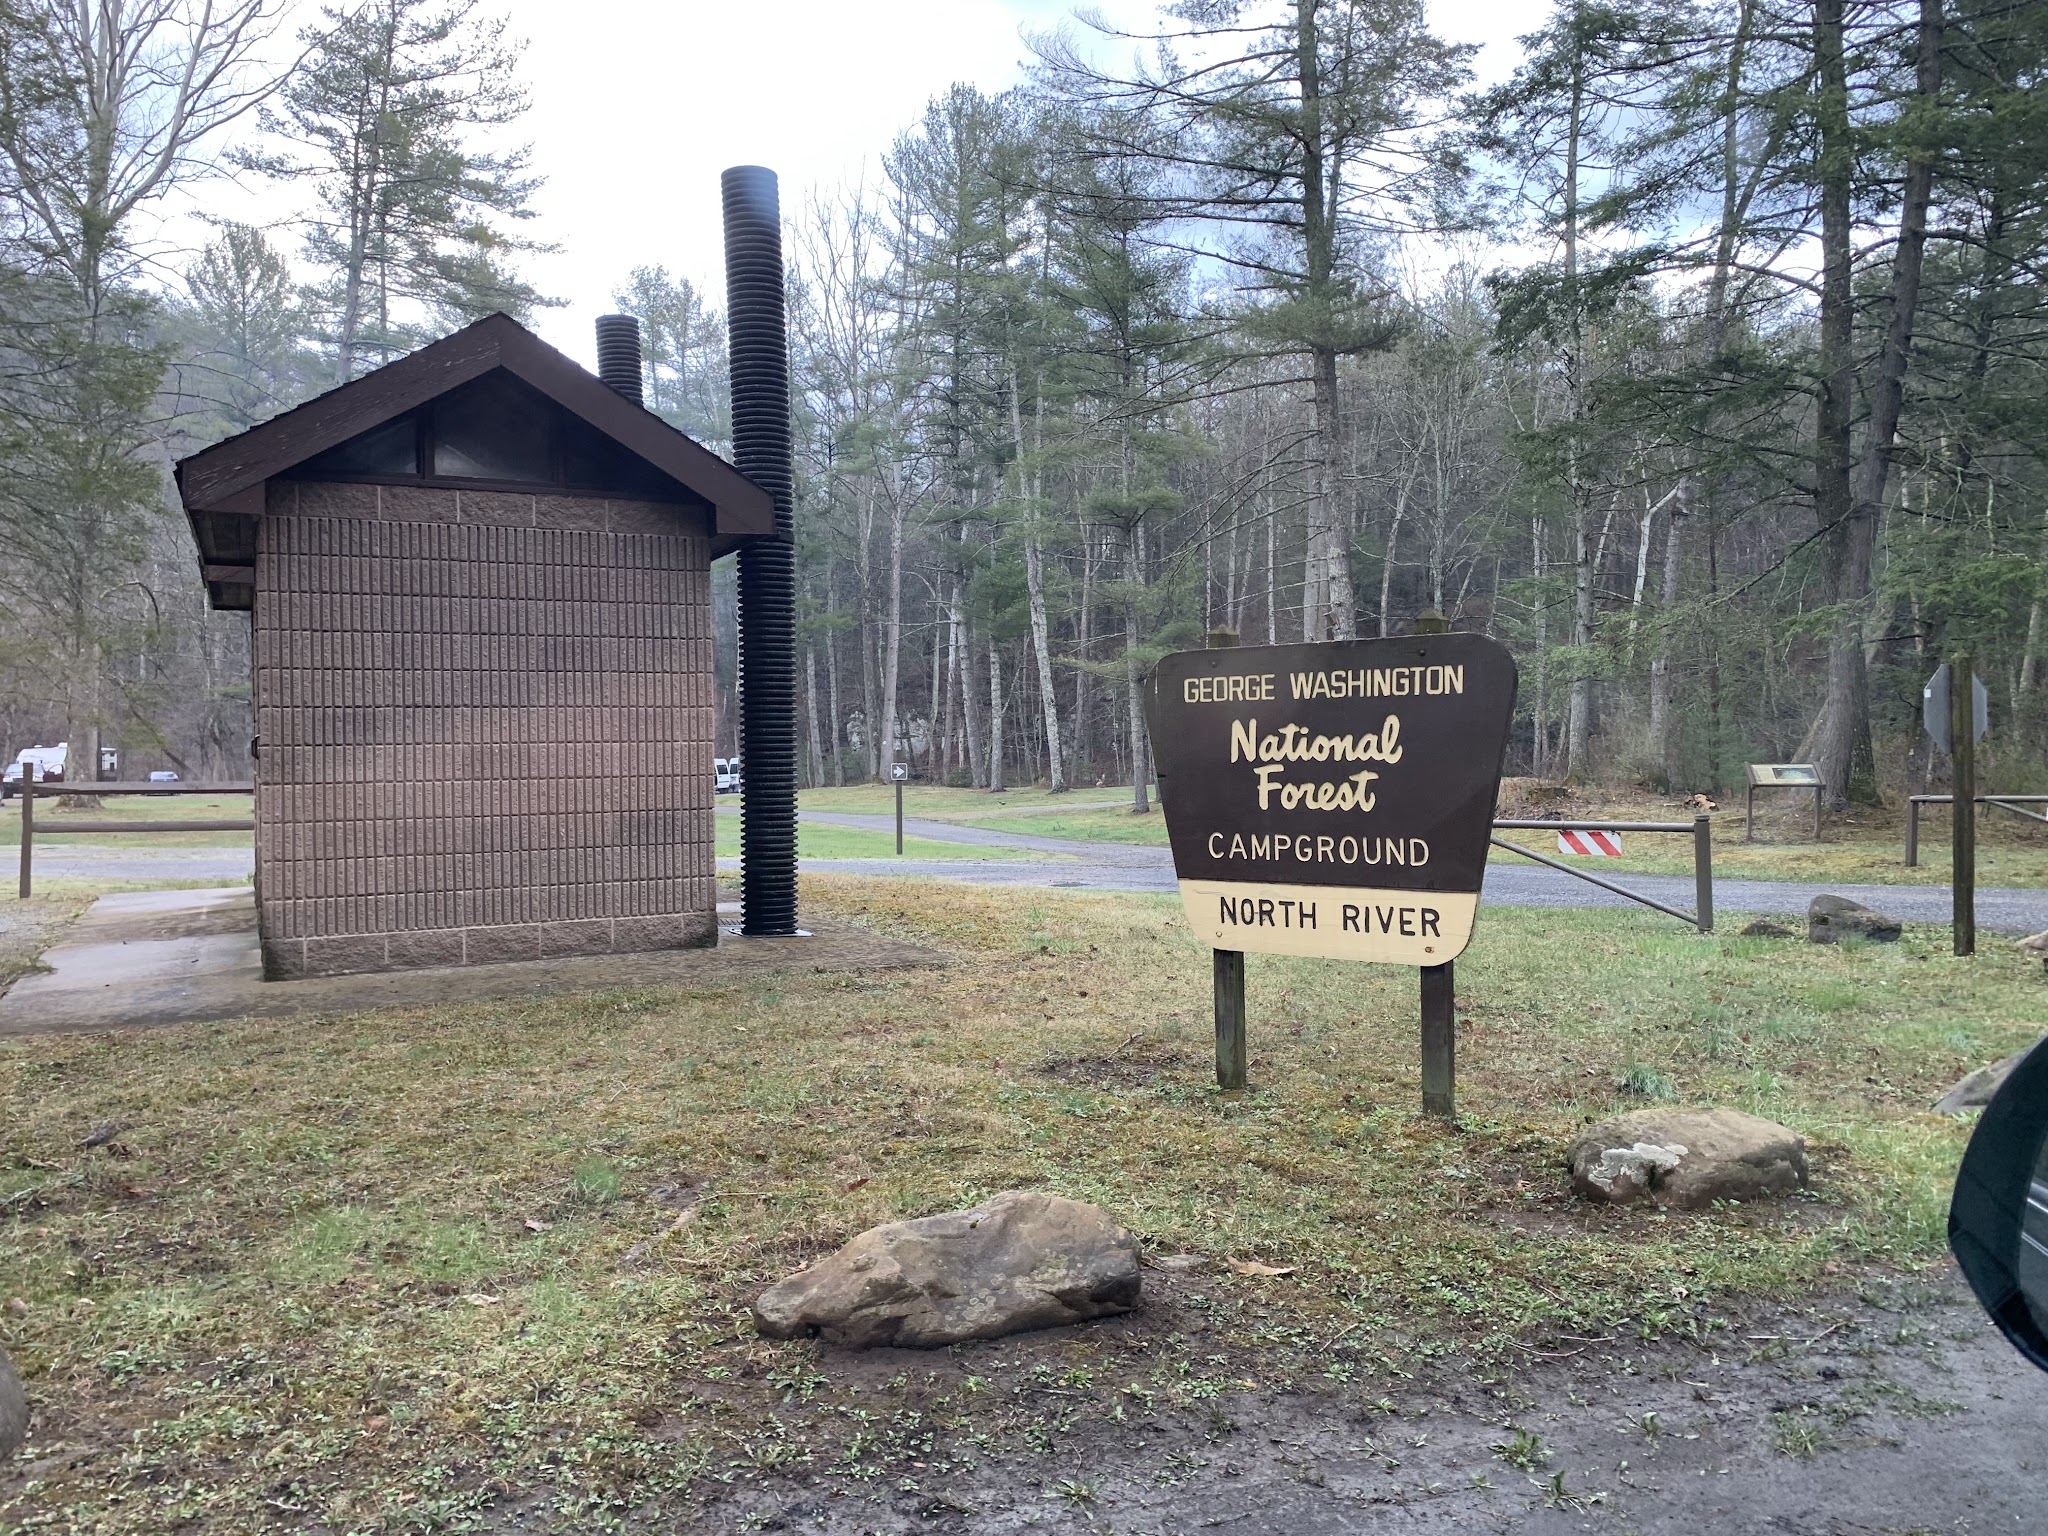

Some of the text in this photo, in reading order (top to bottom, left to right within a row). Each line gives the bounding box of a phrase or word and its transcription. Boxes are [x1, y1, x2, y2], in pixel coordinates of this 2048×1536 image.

[1183, 664, 1464, 703] GEORGE WASHINGTON
[1230, 714, 1403, 764] National
[1253, 764, 1380, 813] Forest
[1207, 832, 1430, 867] CAMPGROUND
[1219, 896, 1441, 938] NORTH RIVER
